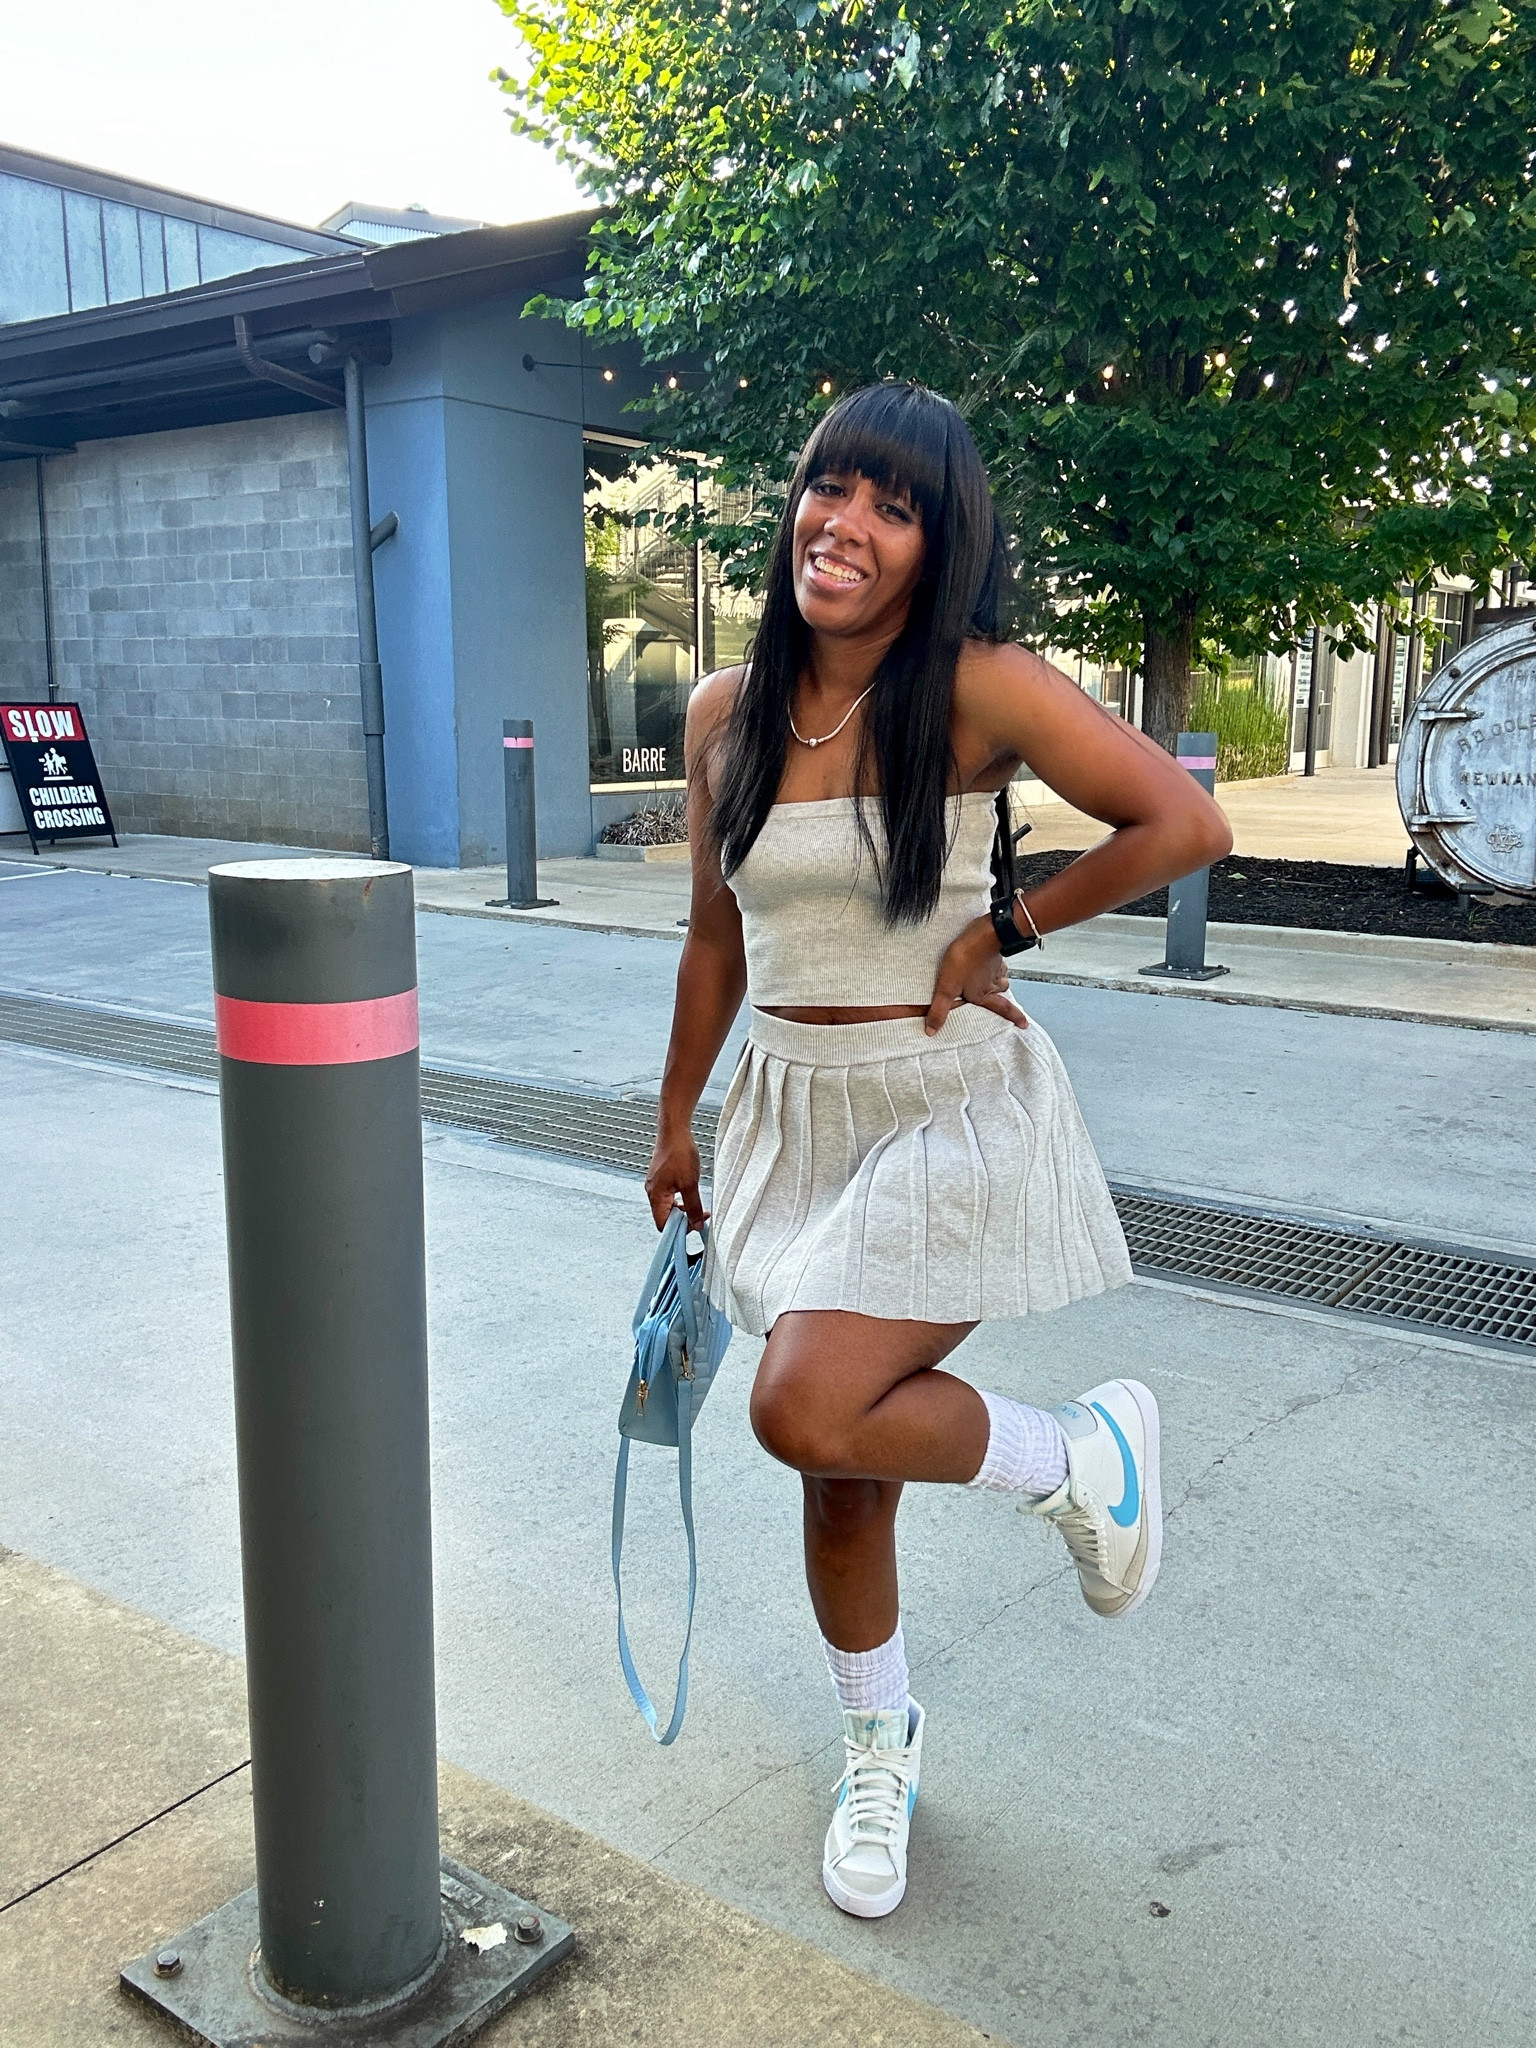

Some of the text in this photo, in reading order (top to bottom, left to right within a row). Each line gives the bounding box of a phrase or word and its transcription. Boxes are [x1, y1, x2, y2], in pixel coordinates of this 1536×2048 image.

[8, 710, 75, 739] SLOW
[622, 748, 667, 772] BARRE
[29, 785, 98, 807] CHILDREN
[33, 807, 106, 829] CROSSING
